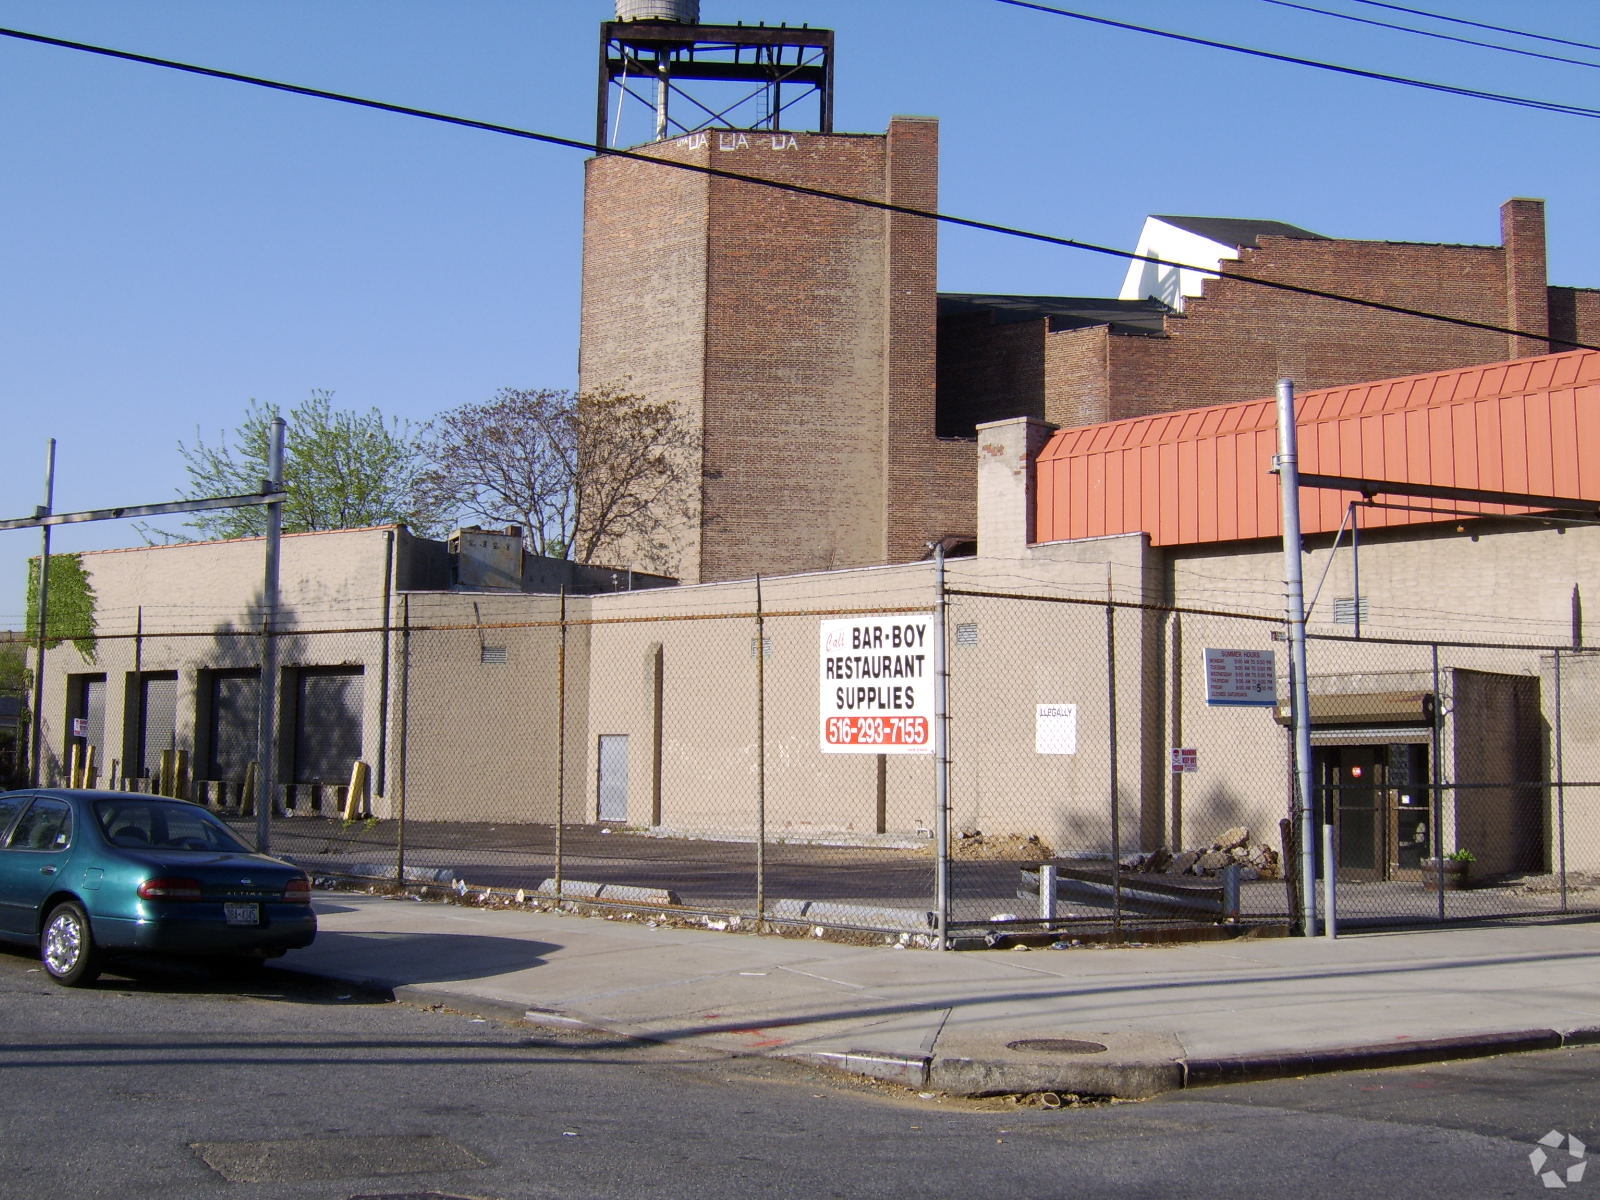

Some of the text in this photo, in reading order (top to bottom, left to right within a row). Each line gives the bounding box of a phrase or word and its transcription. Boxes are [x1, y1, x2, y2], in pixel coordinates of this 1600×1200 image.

[826, 632, 845, 653] Call
[826, 654, 925, 680] RESTAURANT
[836, 686, 915, 710] SUPPLIES
[828, 718, 925, 744] 516-293-7155
